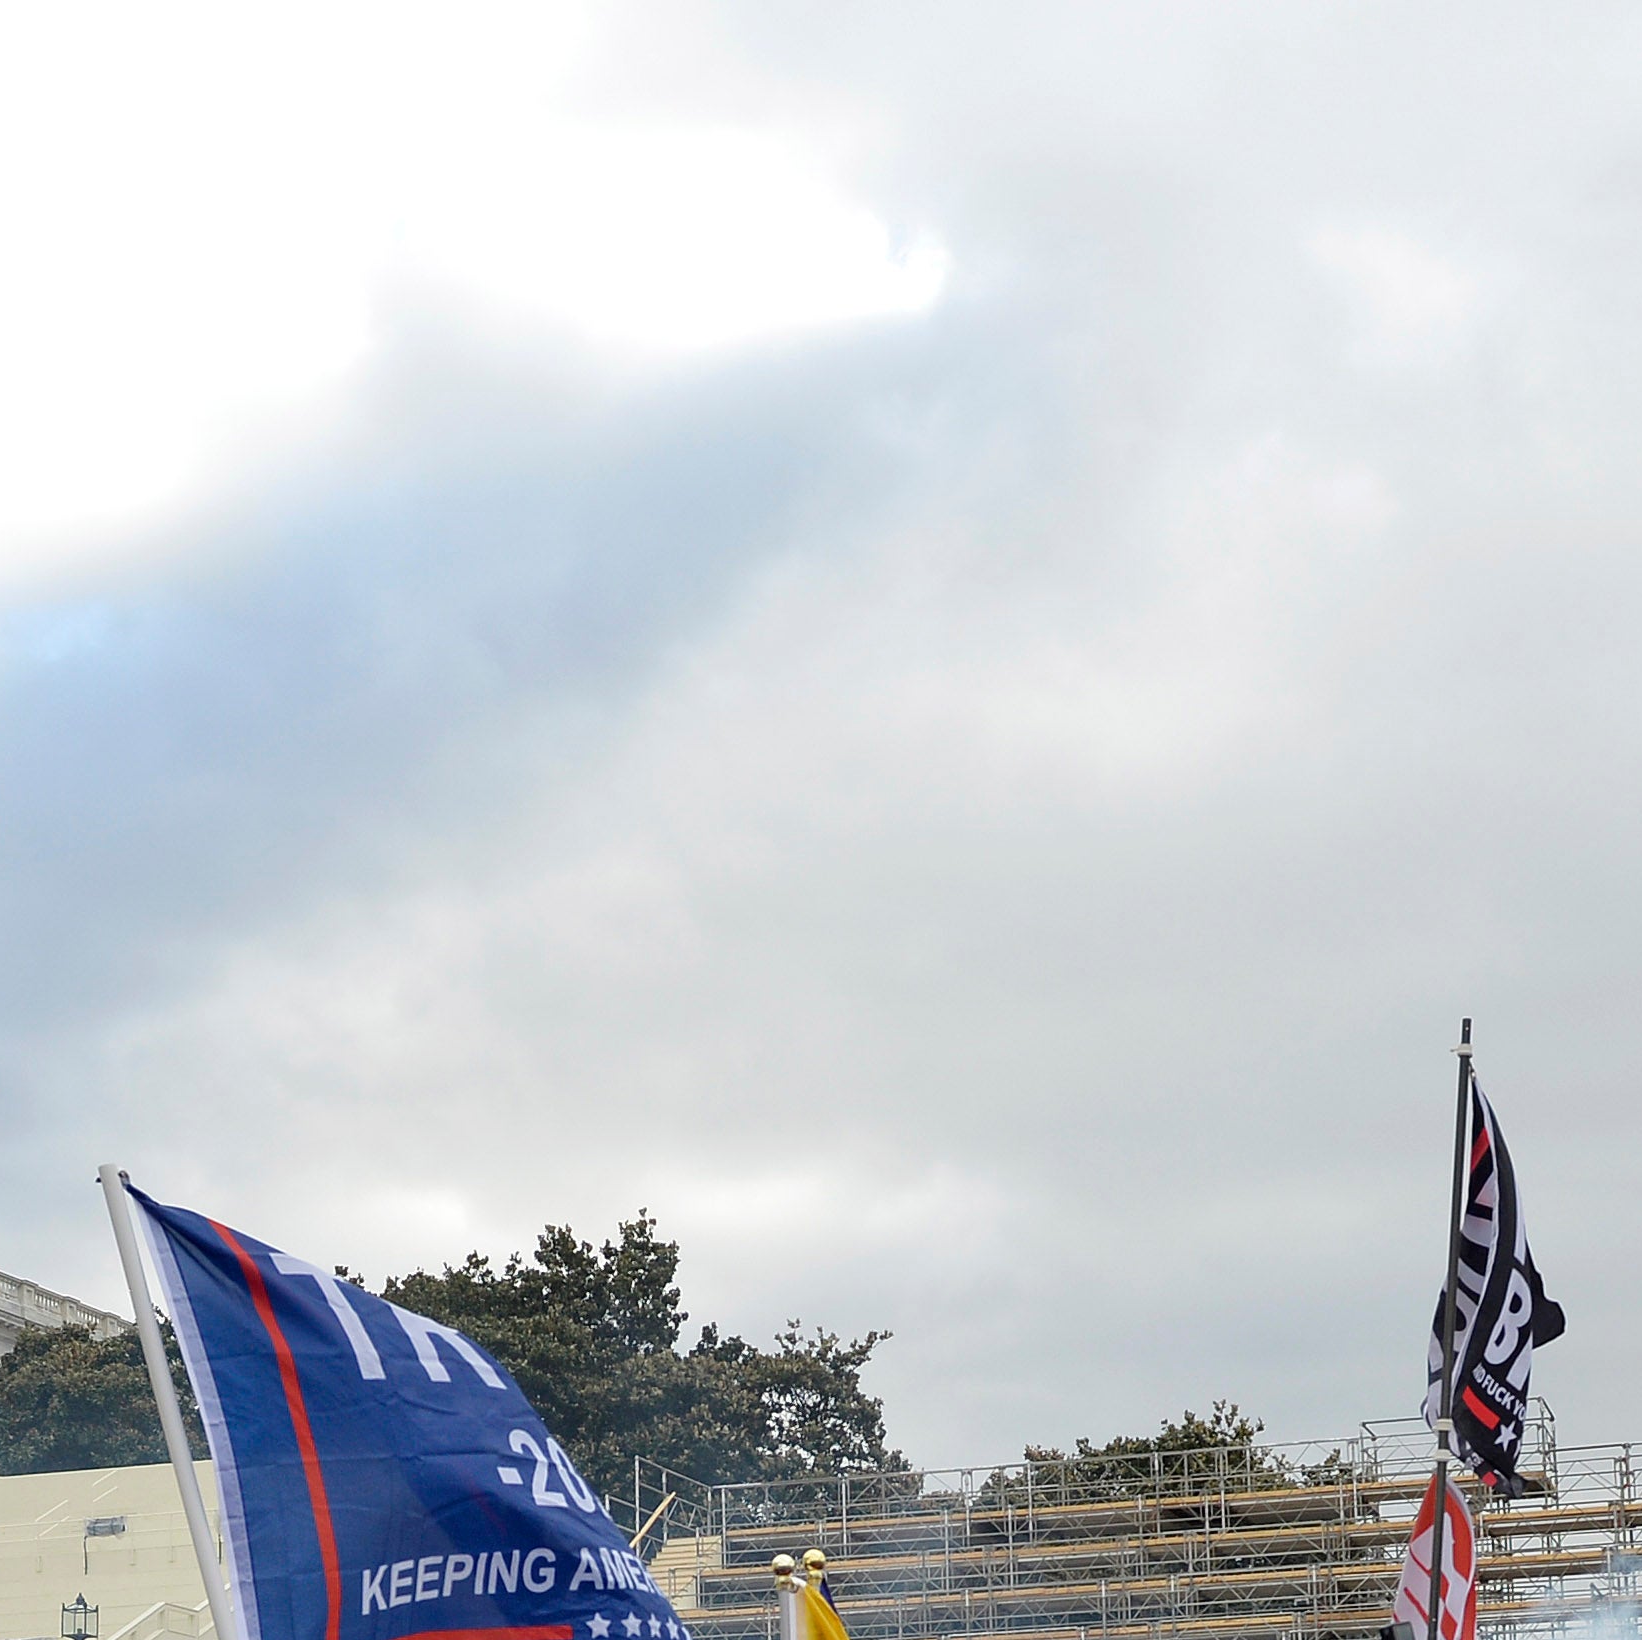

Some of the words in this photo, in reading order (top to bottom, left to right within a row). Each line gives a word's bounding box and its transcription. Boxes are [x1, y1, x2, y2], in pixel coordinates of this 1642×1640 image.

[1481, 1371, 1514, 1410] FUCK
[1512, 1398, 1527, 1421] YO
[360, 1547, 557, 1616] KEEPING
